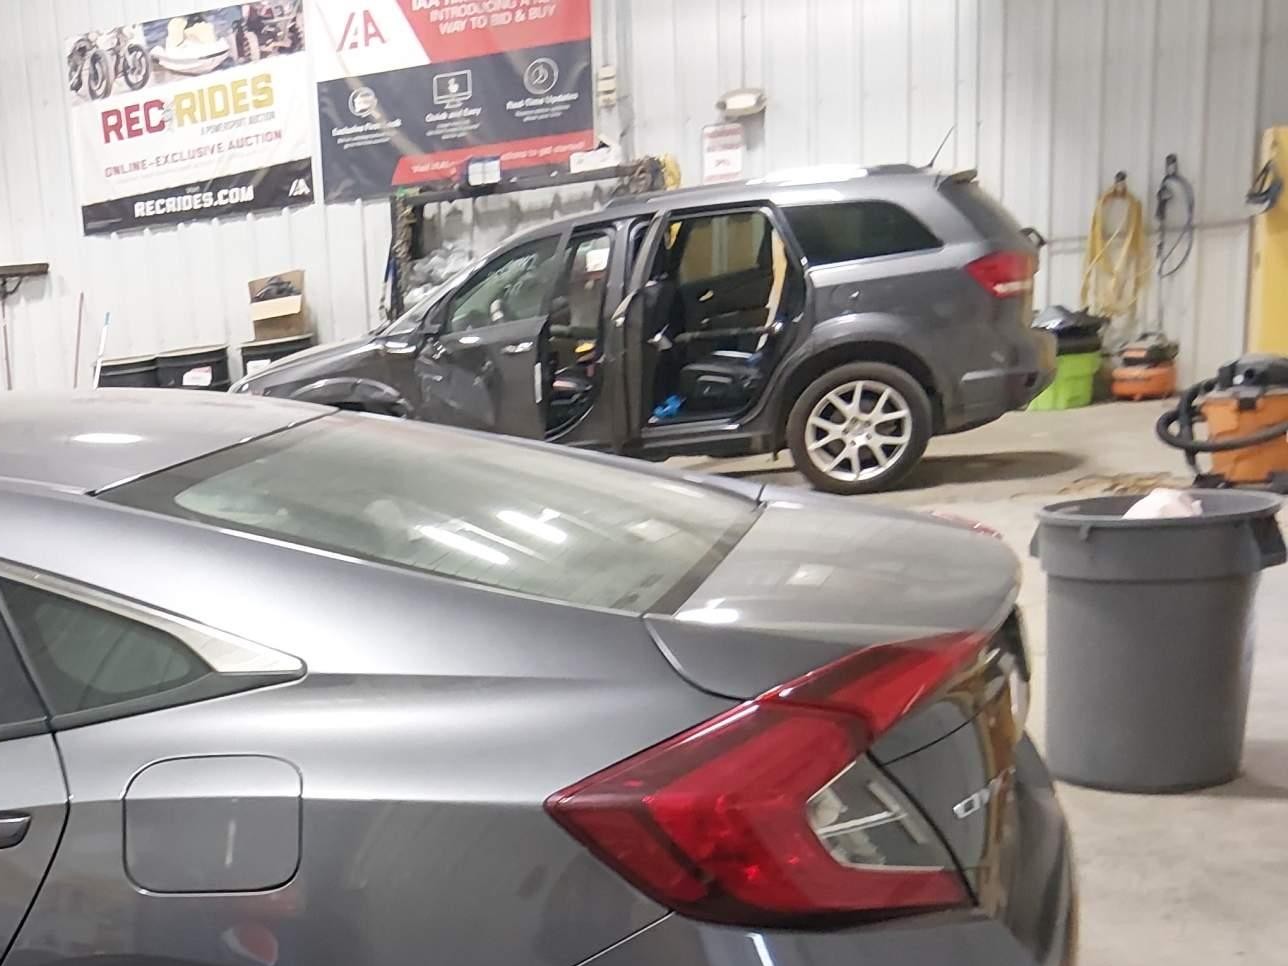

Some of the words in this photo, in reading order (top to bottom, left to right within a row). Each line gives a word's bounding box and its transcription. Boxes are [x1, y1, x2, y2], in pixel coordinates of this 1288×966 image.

[439, 21, 468, 35] WAY
[471, 17, 488, 30] TO
[491, 12, 512, 26] BID
[514, 10, 527, 22] &
[528, 5, 556, 21] BUY
[101, 99, 165, 144] REC
[174, 74, 275, 128] RIDES
[228, 130, 283, 151] AUCTION
[134, 185, 255, 218] RECRIDES.COM
